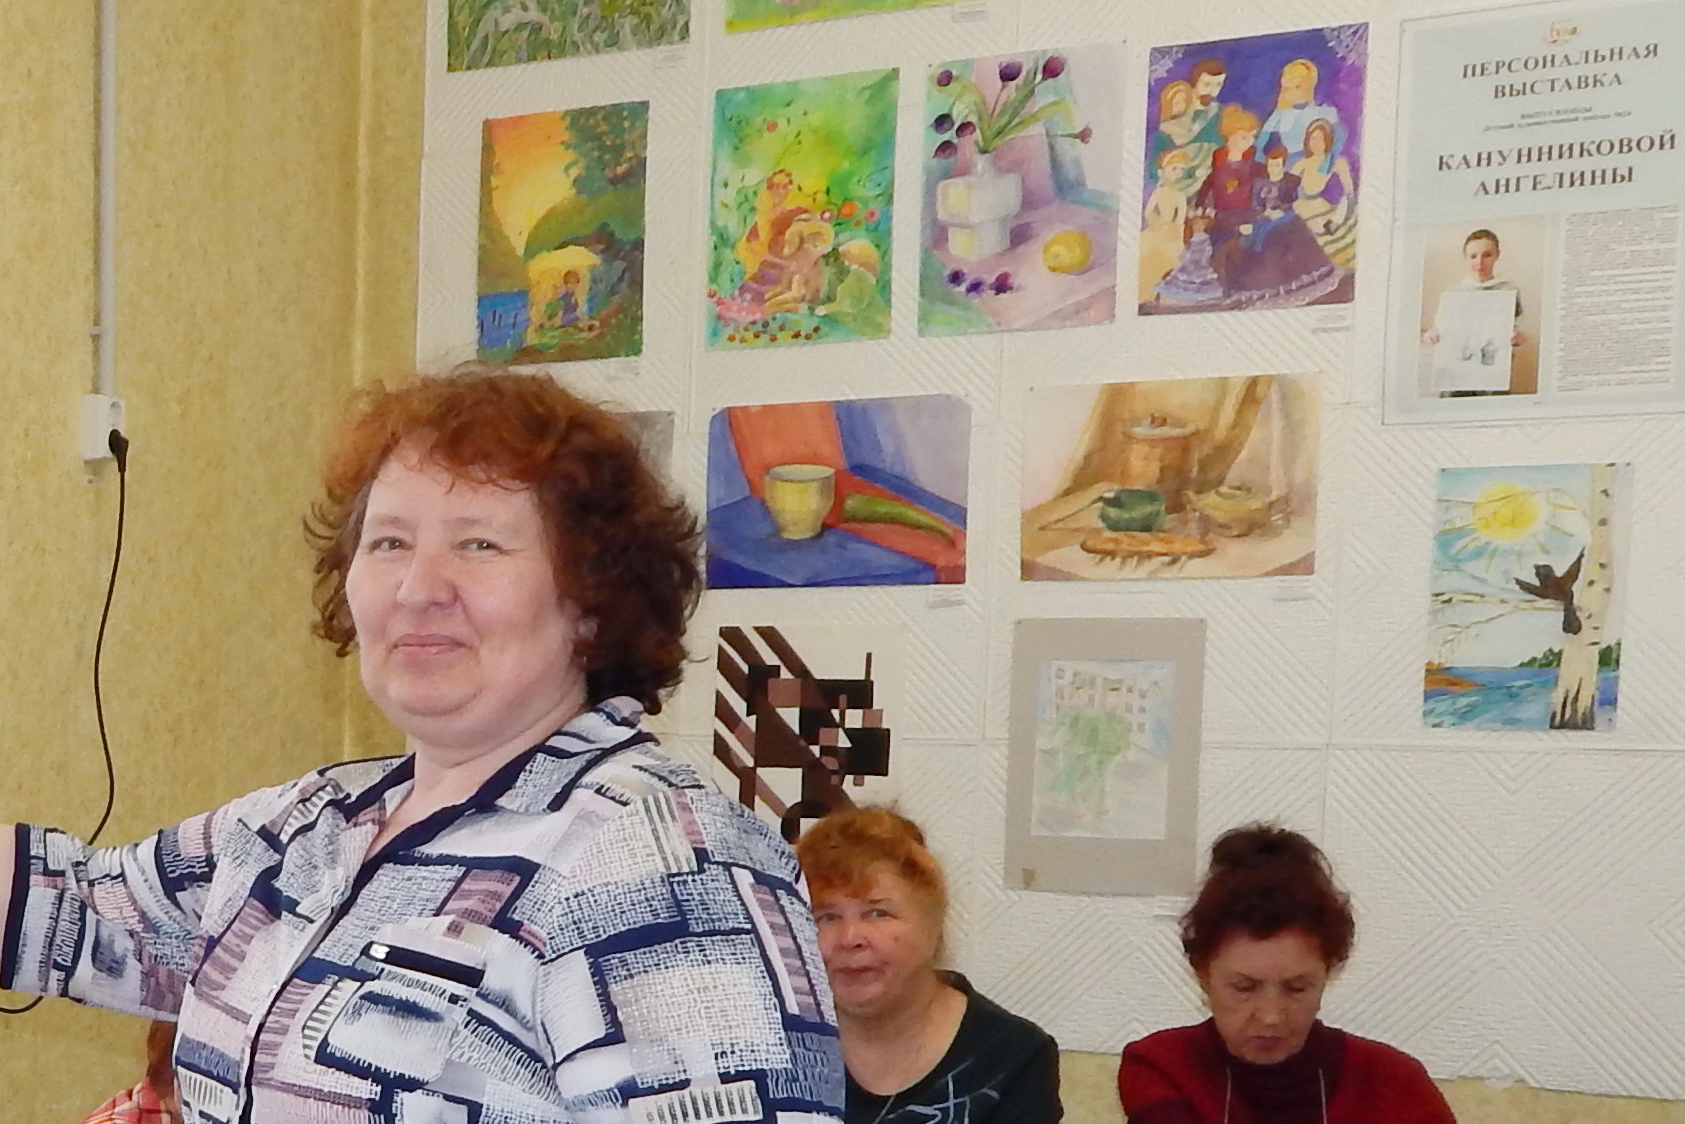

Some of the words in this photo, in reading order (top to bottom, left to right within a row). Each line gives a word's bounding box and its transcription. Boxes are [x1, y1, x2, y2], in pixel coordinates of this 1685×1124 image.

[1462, 43, 1659, 79] ПЕРСОНАЛЬНАЯ
[1493, 72, 1623, 99] ВЫСТАВКА
[1437, 128, 1677, 171] КАНУННИКОВОЙ
[1473, 165, 1634, 197] АНГЕЛИНЫ
